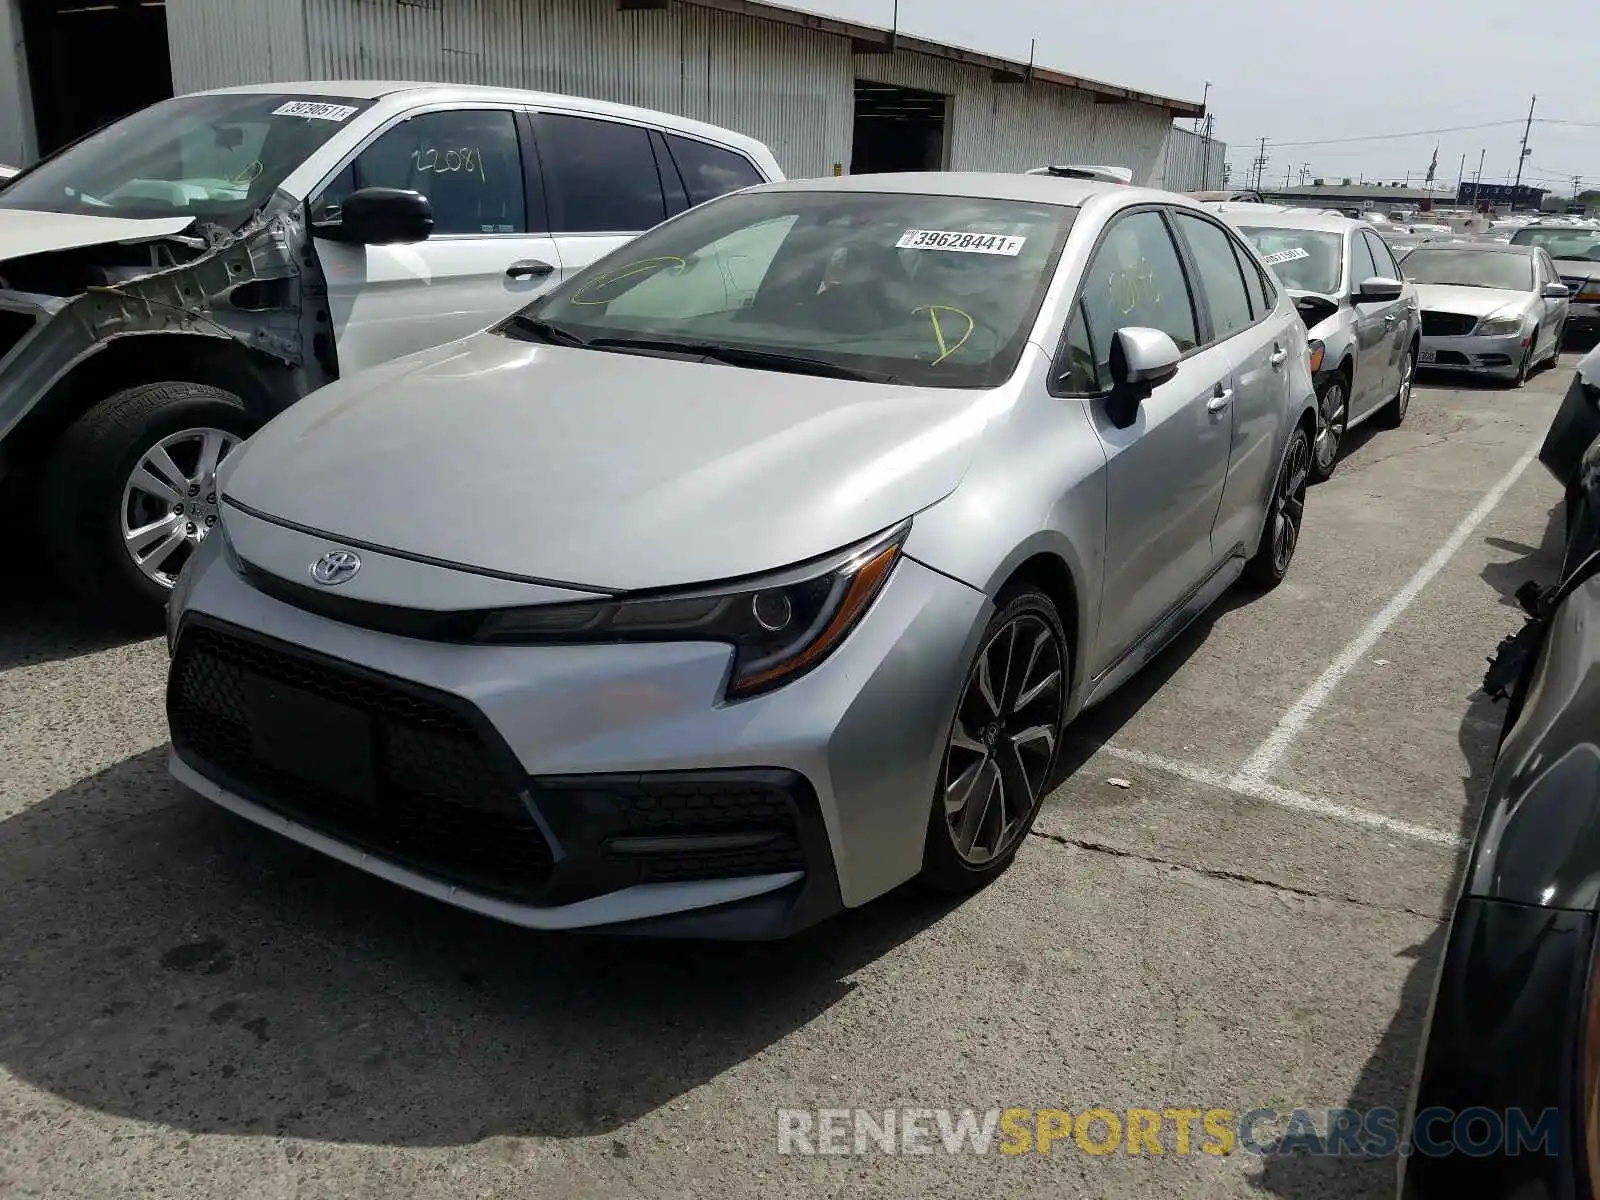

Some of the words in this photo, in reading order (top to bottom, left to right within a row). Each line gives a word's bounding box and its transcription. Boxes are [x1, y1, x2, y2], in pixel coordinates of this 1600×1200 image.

[411, 146, 486, 183] 22081
[914, 231, 1007, 251] 39628441
[911, 304, 974, 367] D
